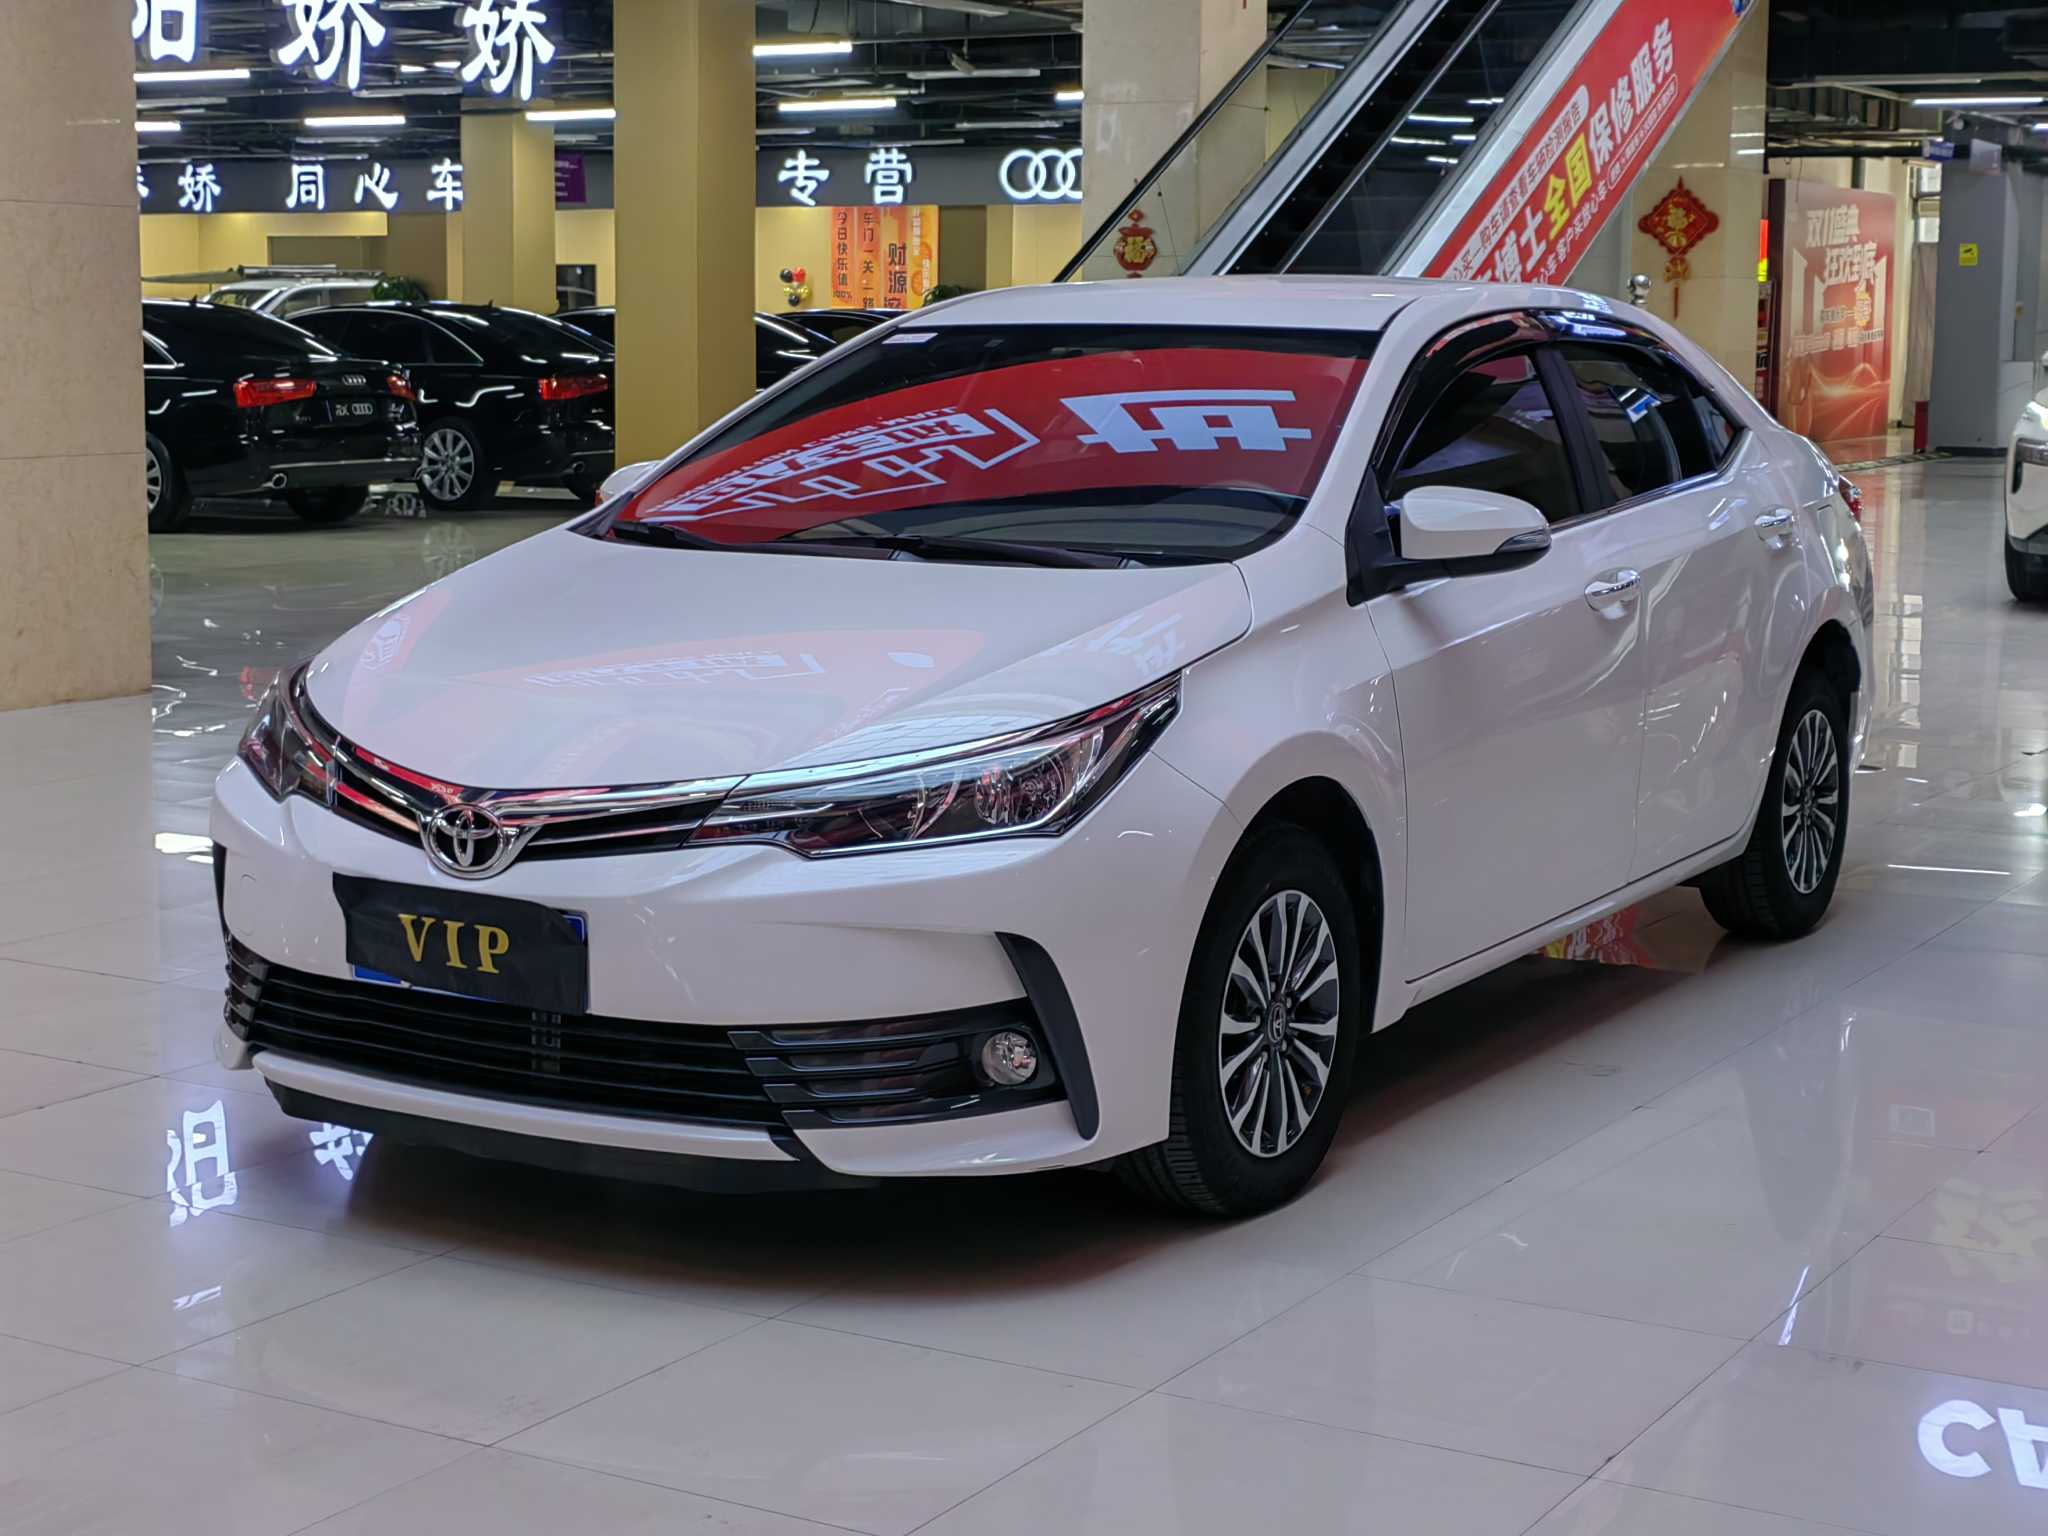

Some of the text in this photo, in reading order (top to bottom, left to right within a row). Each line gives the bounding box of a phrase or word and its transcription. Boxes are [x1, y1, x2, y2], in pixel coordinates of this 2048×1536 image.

[286, 157, 464, 212] 同心车
[777, 148, 913, 206] 专营
[1477, 17, 1674, 282] 博士全国保修服务
[398, 913, 510, 975] VIP
